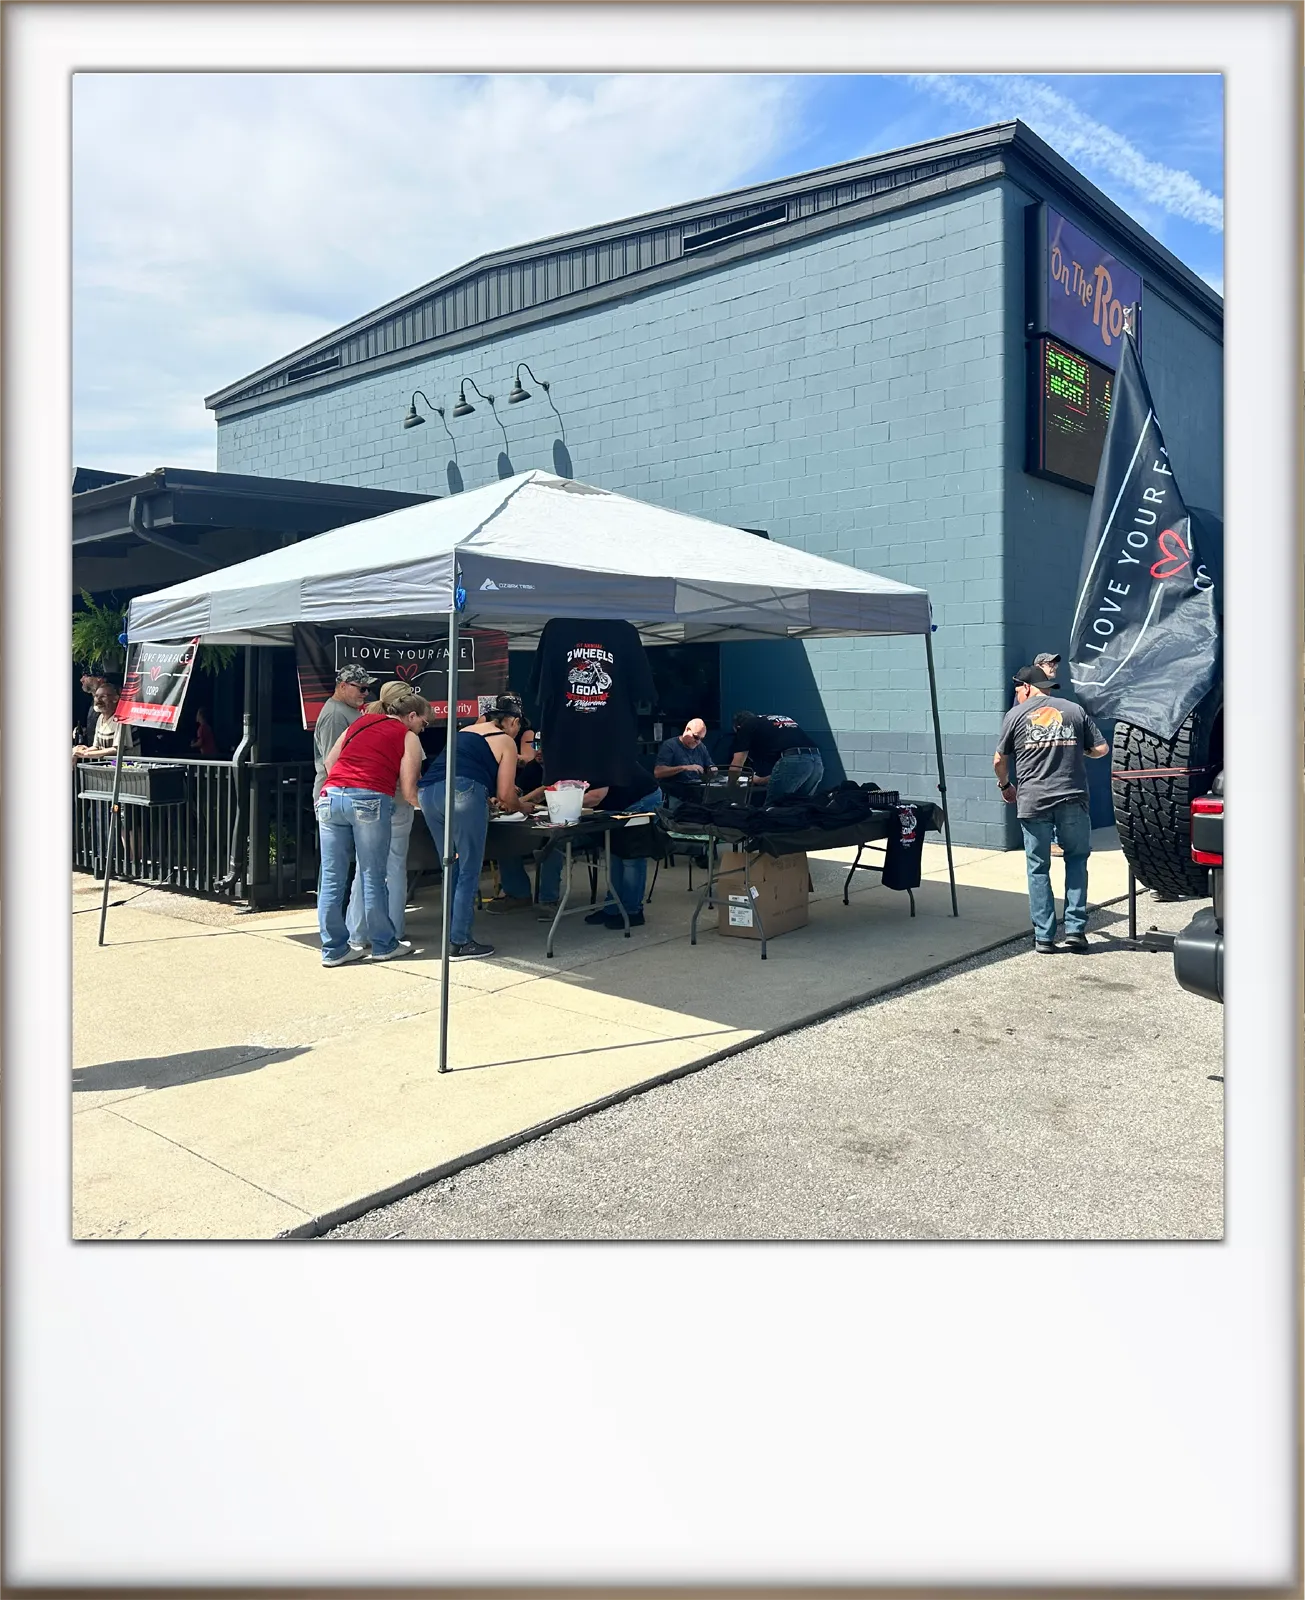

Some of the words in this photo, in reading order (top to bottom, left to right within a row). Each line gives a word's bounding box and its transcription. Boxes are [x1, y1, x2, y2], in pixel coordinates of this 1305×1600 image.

[1051, 246, 1070, 295] On
[1072, 261, 1093, 307] The
[1093, 264, 1132, 346] Ro
[1050, 374, 1084, 405] NIGHT
[1085, 579, 1131, 653] LOVE
[1117, 487, 1167, 565] YOUR
[141, 652, 157, 662] LOVE
[352, 647, 390, 659] LOVE
[436, 647, 467, 659] FAE
[567, 651, 573, 662] 2
[573, 648, 614, 664] WHEELS
[146, 685, 159, 696] CORP
[571, 684, 576, 694] 1
[576, 685, 604, 696] GOAL
